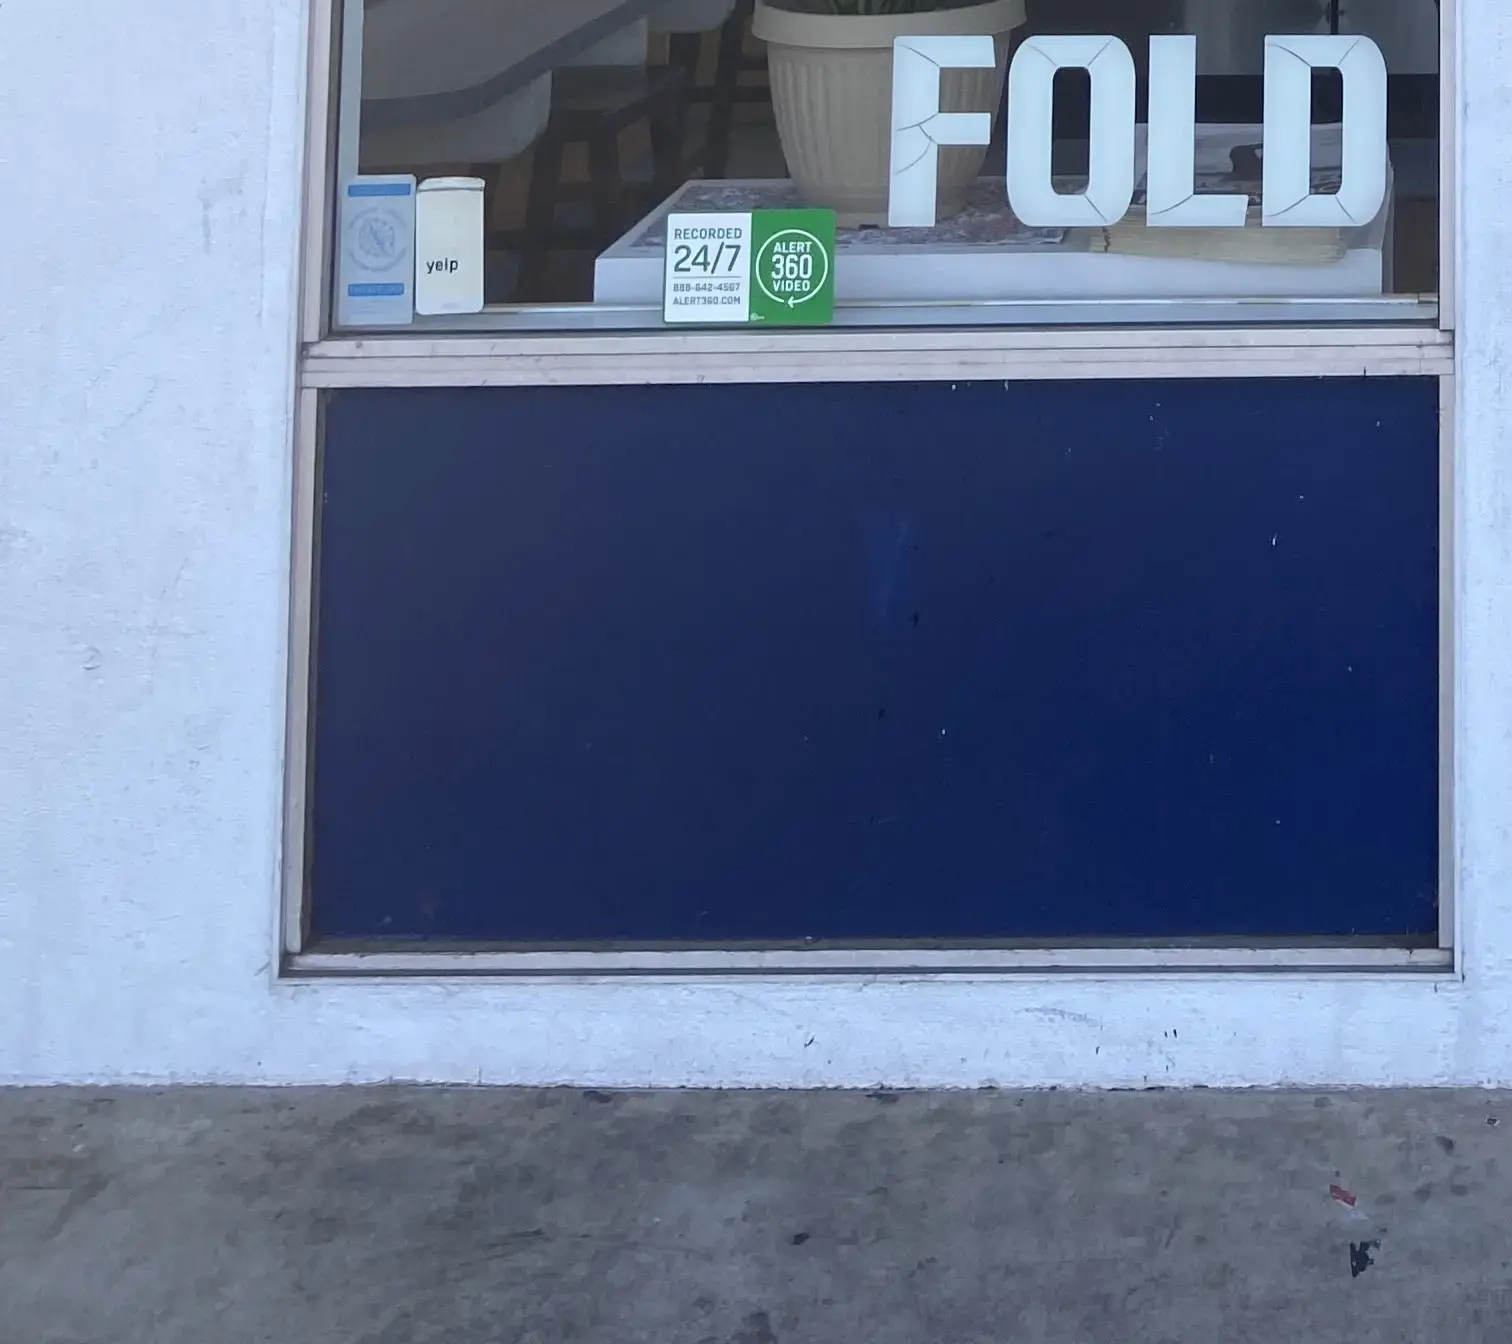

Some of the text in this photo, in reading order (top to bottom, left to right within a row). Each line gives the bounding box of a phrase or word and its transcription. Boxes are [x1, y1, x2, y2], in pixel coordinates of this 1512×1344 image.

[888, 34, 1388, 227] FOLD
[673, 228, 743, 240] RECORDED
[773, 241, 813, 254] ALERT
[673, 242, 742, 274] 24/7
[425, 257, 459, 275] yelp
[771, 254, 812, 279] 360
[773, 279, 811, 292] VIDEO
[672, 296, 741, 306] ALERT360.COM
